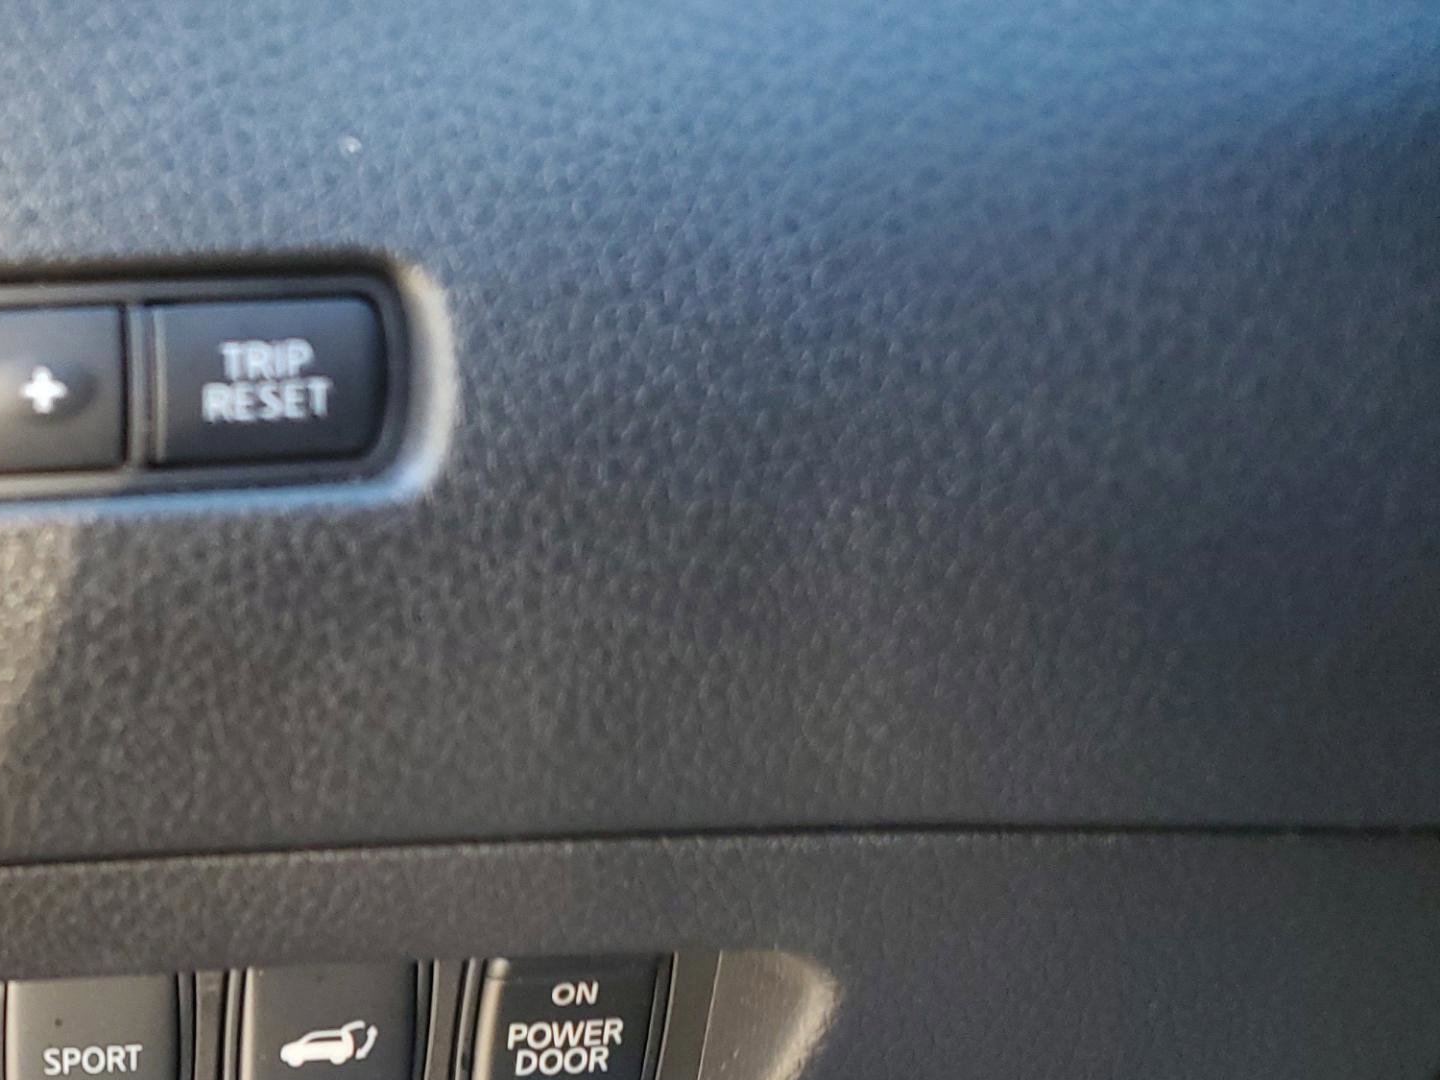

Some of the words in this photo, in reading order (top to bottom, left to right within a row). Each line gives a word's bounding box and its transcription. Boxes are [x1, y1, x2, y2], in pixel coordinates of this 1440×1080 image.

[221, 337, 315, 381] TRIP
[201, 375, 333, 422] RESET
[551, 979, 599, 1006] ON
[507, 1017, 624, 1050] POWER
[43, 1044, 143, 1077] SPORT
[515, 1046, 610, 1076] DOOR
